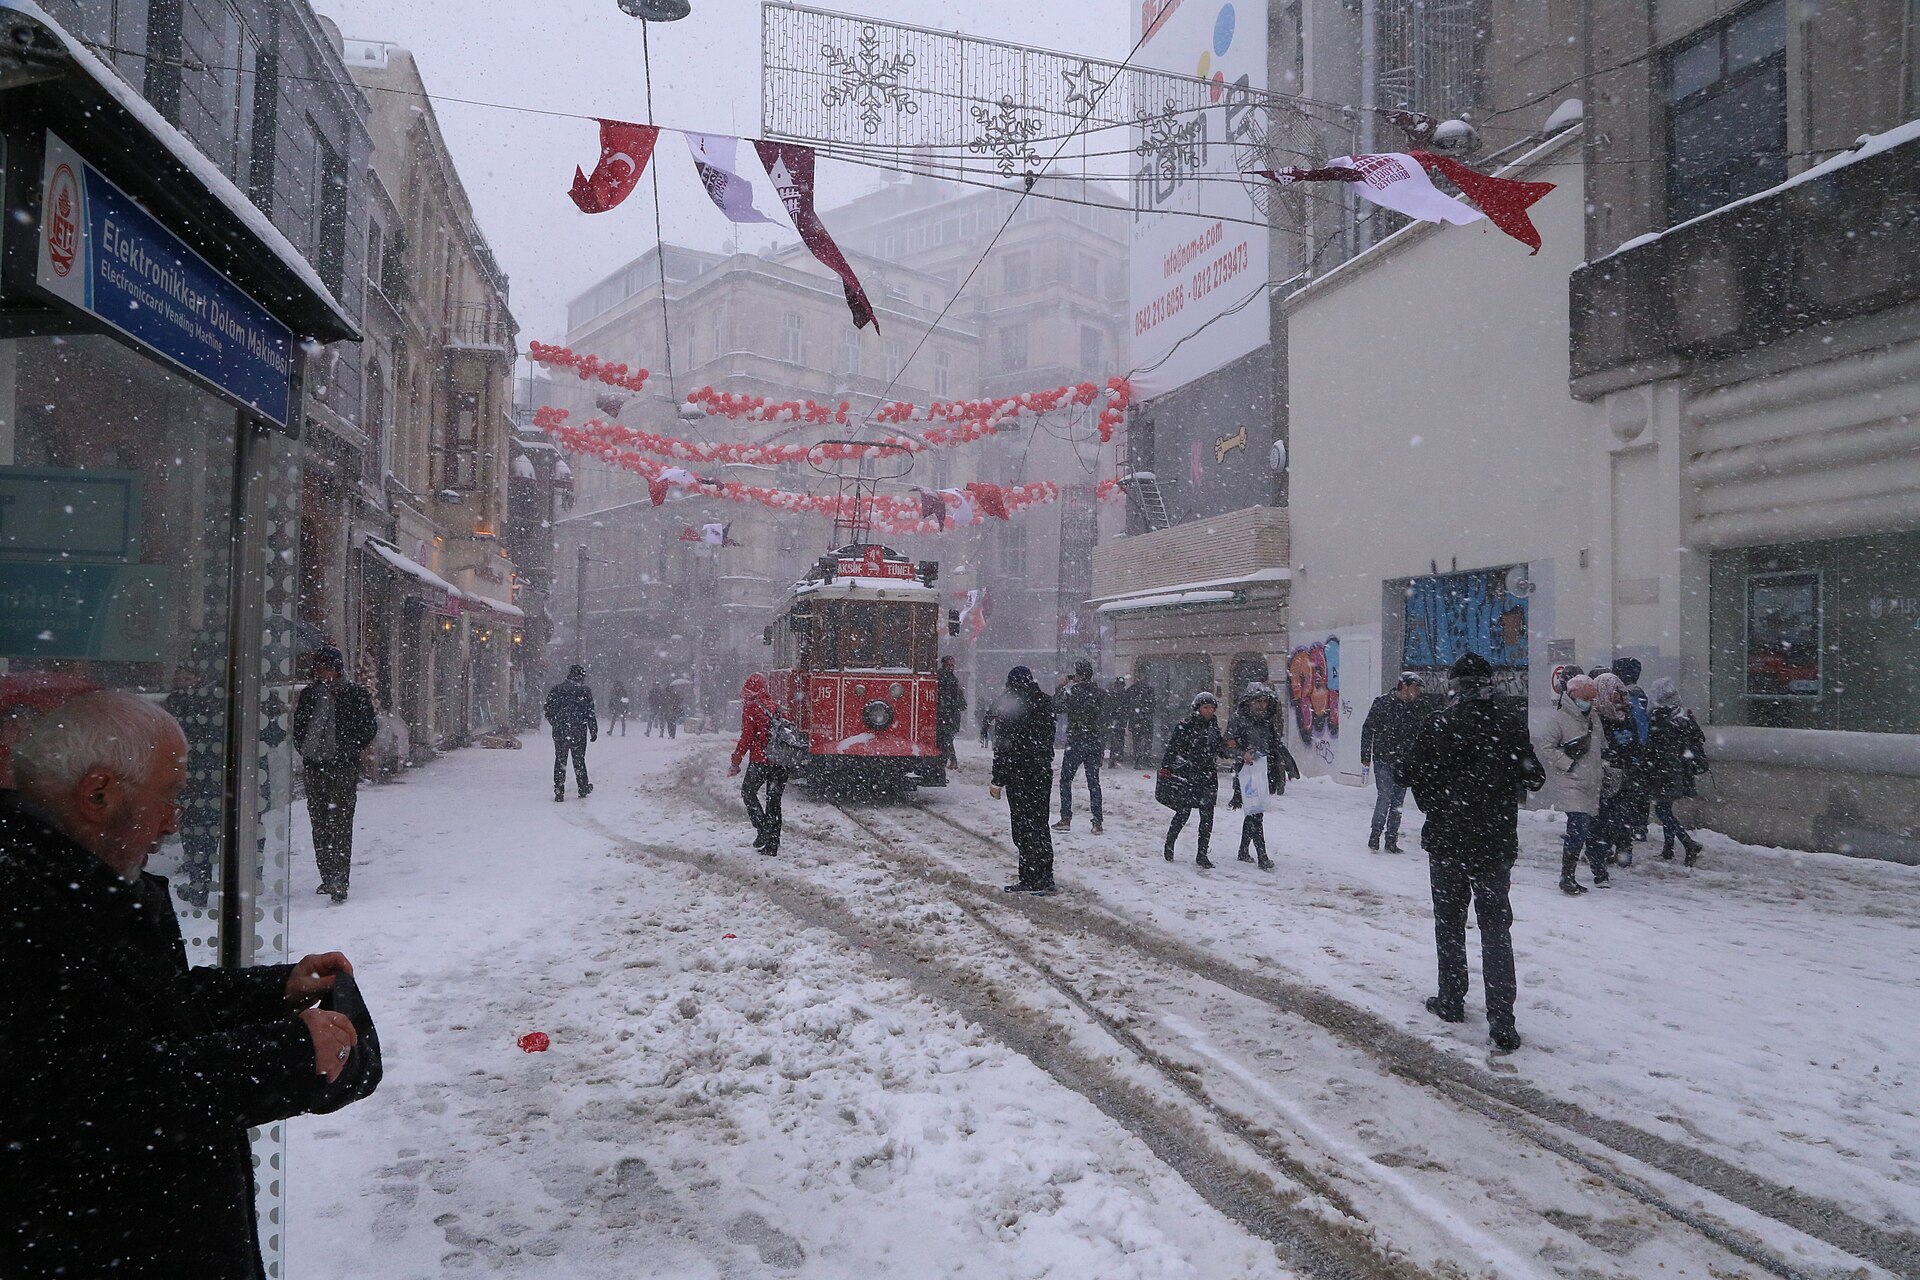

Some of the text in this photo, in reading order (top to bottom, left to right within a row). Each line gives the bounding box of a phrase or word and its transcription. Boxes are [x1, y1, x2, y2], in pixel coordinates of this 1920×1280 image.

[1163, 221, 1223, 279] info@nom-e.com
[103, 218, 288, 376] Elektronikkart Dolum Makinesi
[1135, 305, 1151, 336] 0542
[1152, 296, 1165, 326] 213
[1192, 265, 1212, 301] 0212
[1213, 240, 1248, 289] 2759473
[165, 302, 195, 338] Vending
[195, 321, 223, 351] Machine
[887, 563, 913, 576] TÜNEL
[818, 686, 832, 699] 115
